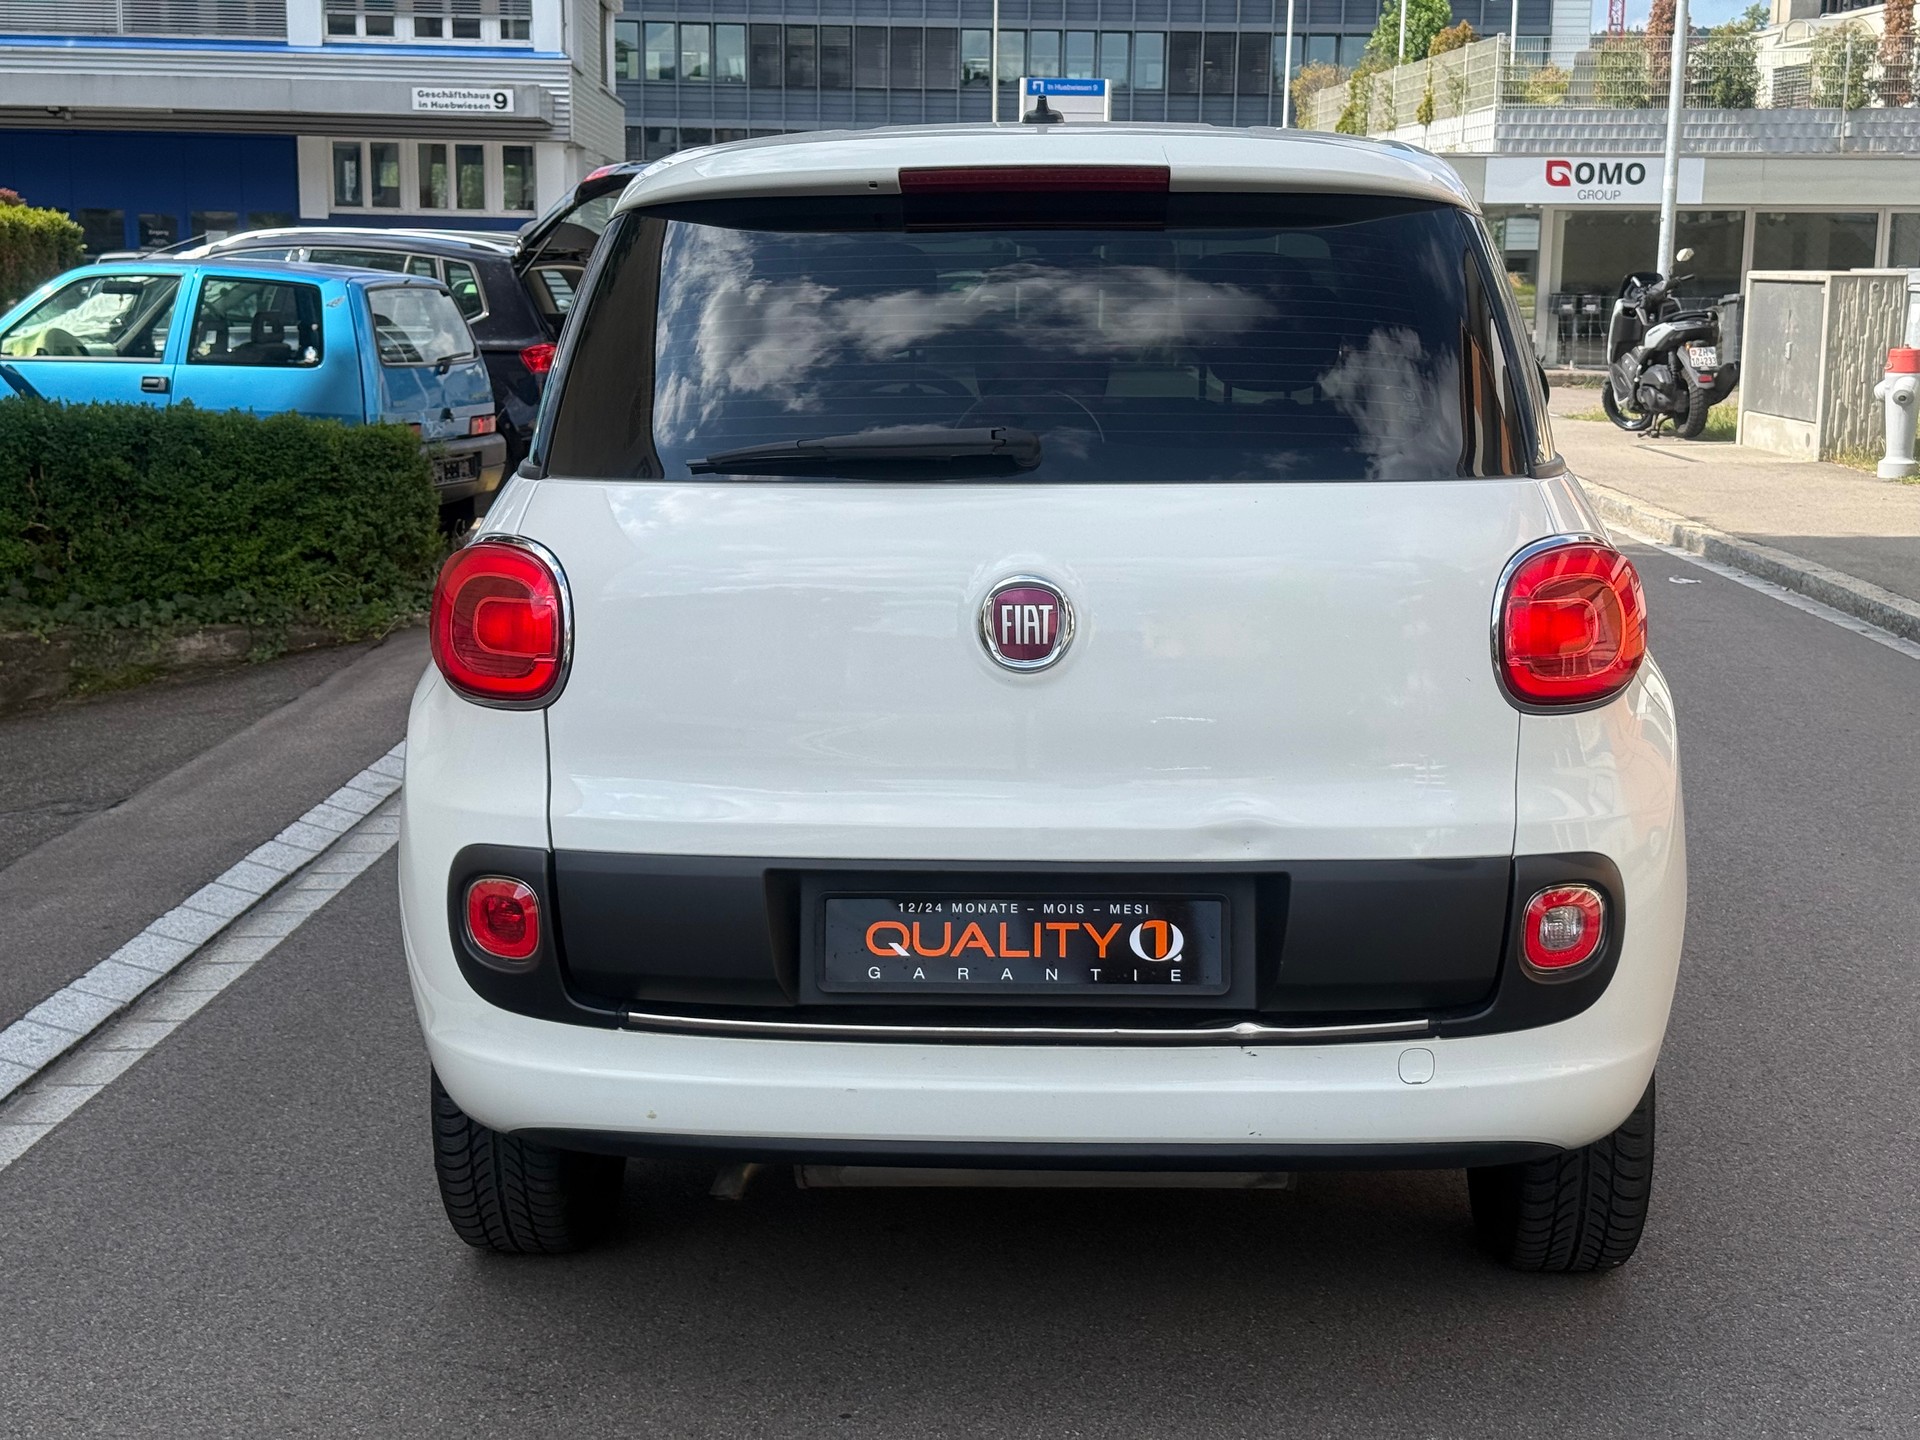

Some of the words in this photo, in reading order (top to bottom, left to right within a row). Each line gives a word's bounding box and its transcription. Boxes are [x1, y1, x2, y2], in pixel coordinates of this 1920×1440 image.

[417, 90, 490, 100] Geschäftshaus
[493, 92, 508, 110] 9
[431, 101, 490, 109] Huebwiesen
[1577, 189, 1621, 201] GROUP
[1001, 604, 1054, 645] FIAT
[897, 902, 943, 914] 12/24
[951, 903, 1019, 914] MONATE
[1043, 903, 1085, 915] MOIS
[1109, 904, 1150, 915] MESI
[865, 920, 1122, 959] QUALITY
[868, 966, 1182, 983] GARANTIE
